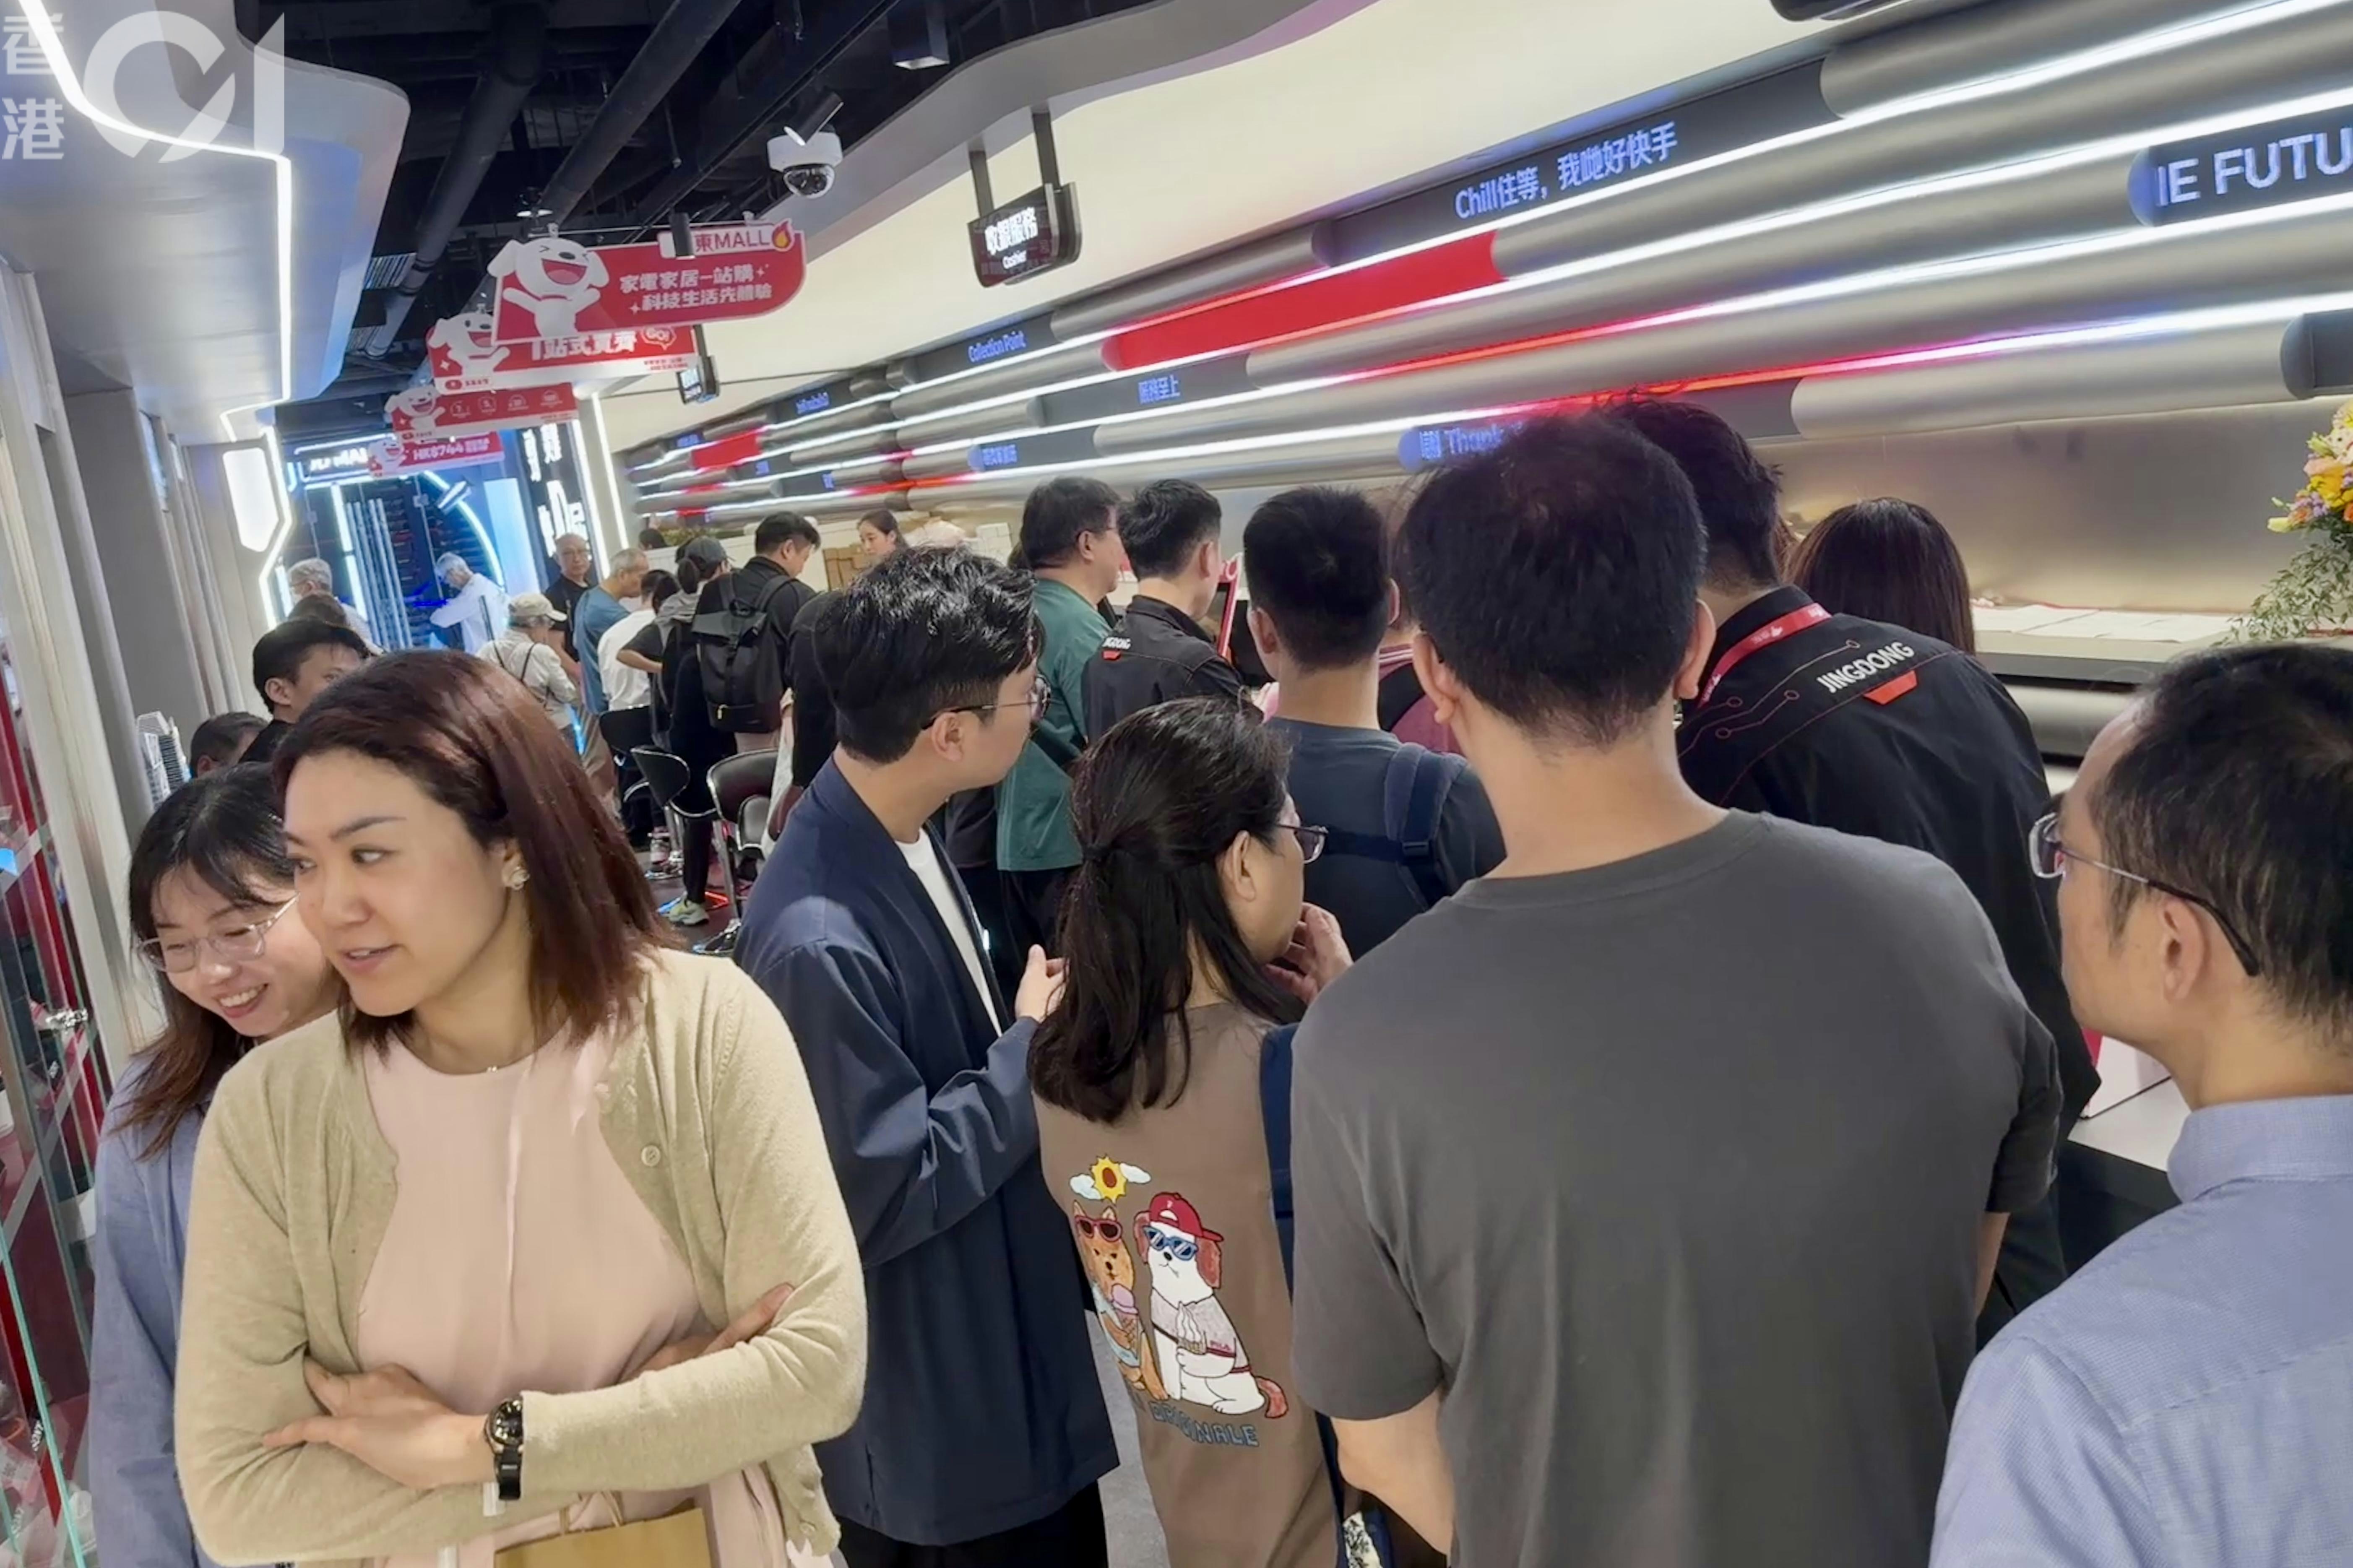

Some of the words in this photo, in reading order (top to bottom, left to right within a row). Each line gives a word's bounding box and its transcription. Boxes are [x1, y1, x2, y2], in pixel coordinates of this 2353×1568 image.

[620, 264, 754, 294] 家電家居一站購
[642, 283, 773, 311] 科技生活先體驗
[968, 338, 1005, 363] Collection
[1003, 330, 1026, 352] Point
[1816, 641, 1915, 693] JINGDONG
